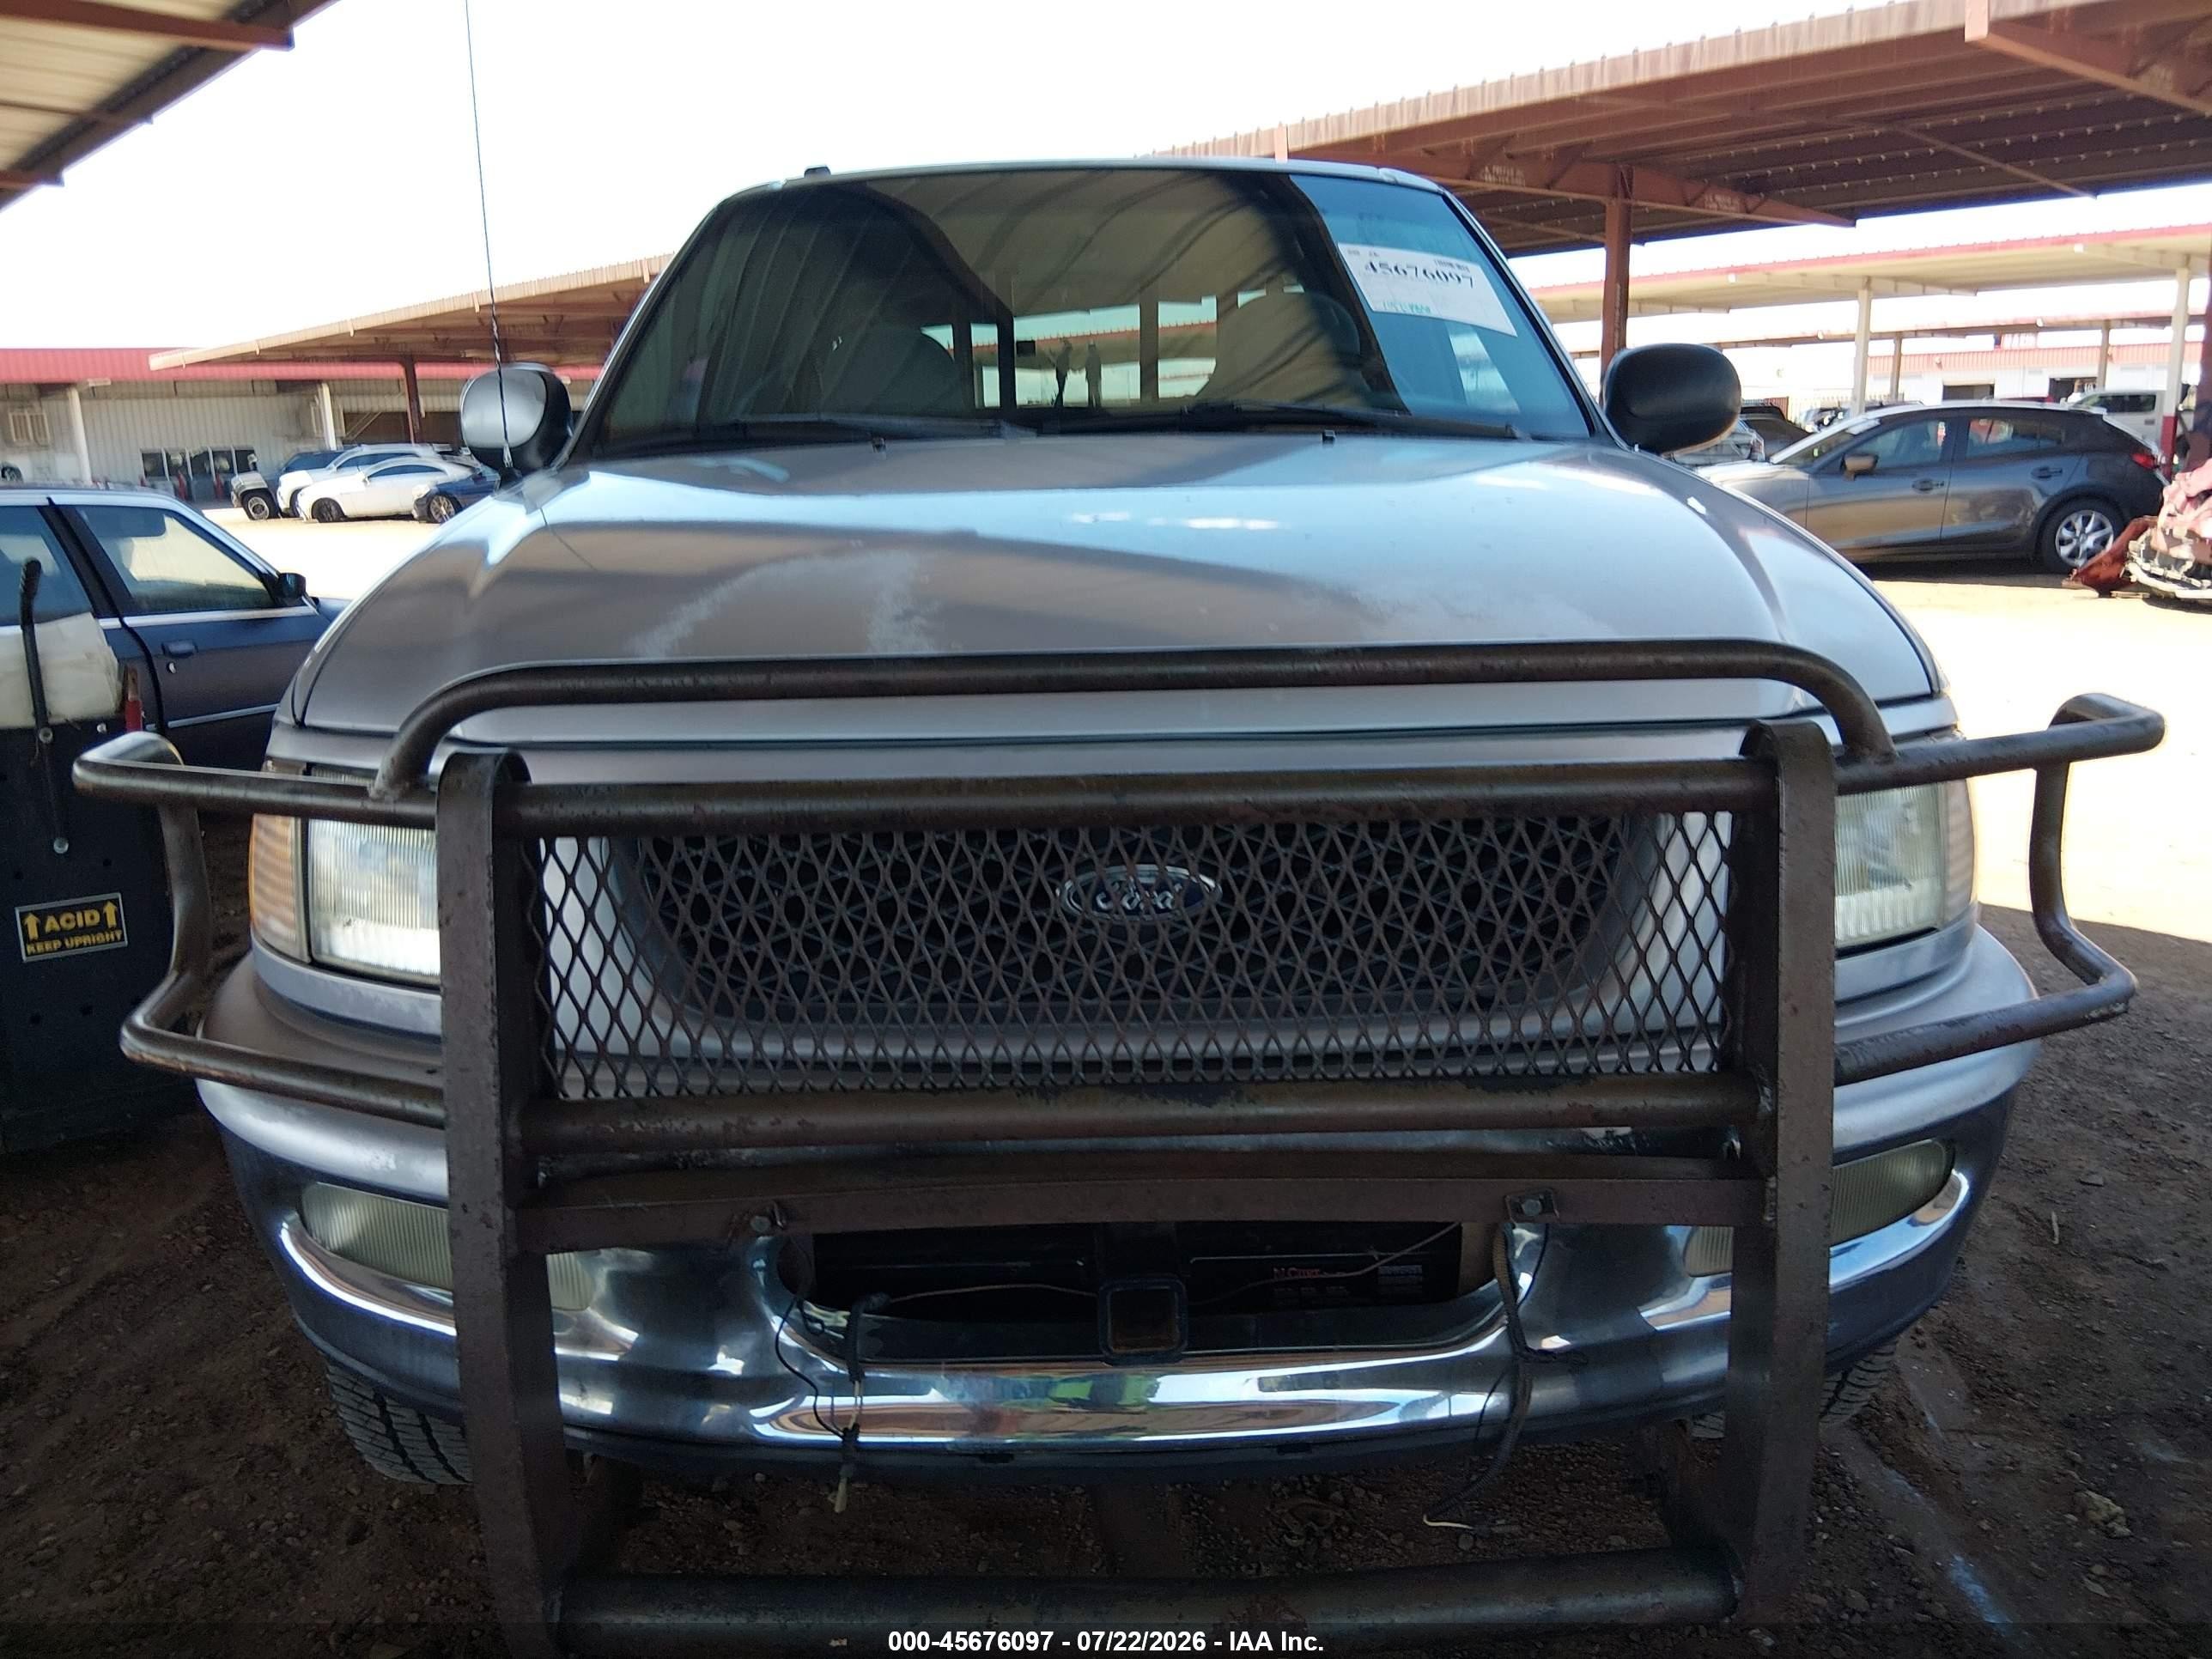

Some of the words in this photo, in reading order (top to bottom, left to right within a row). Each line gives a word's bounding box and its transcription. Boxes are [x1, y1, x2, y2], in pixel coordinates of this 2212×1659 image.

[1365, 261, 1474, 289] 45676097
[45, 909, 101, 933] ACID
[26, 940, 62, 955] KEEP
[65, 930, 123, 949] UPRIGHT
